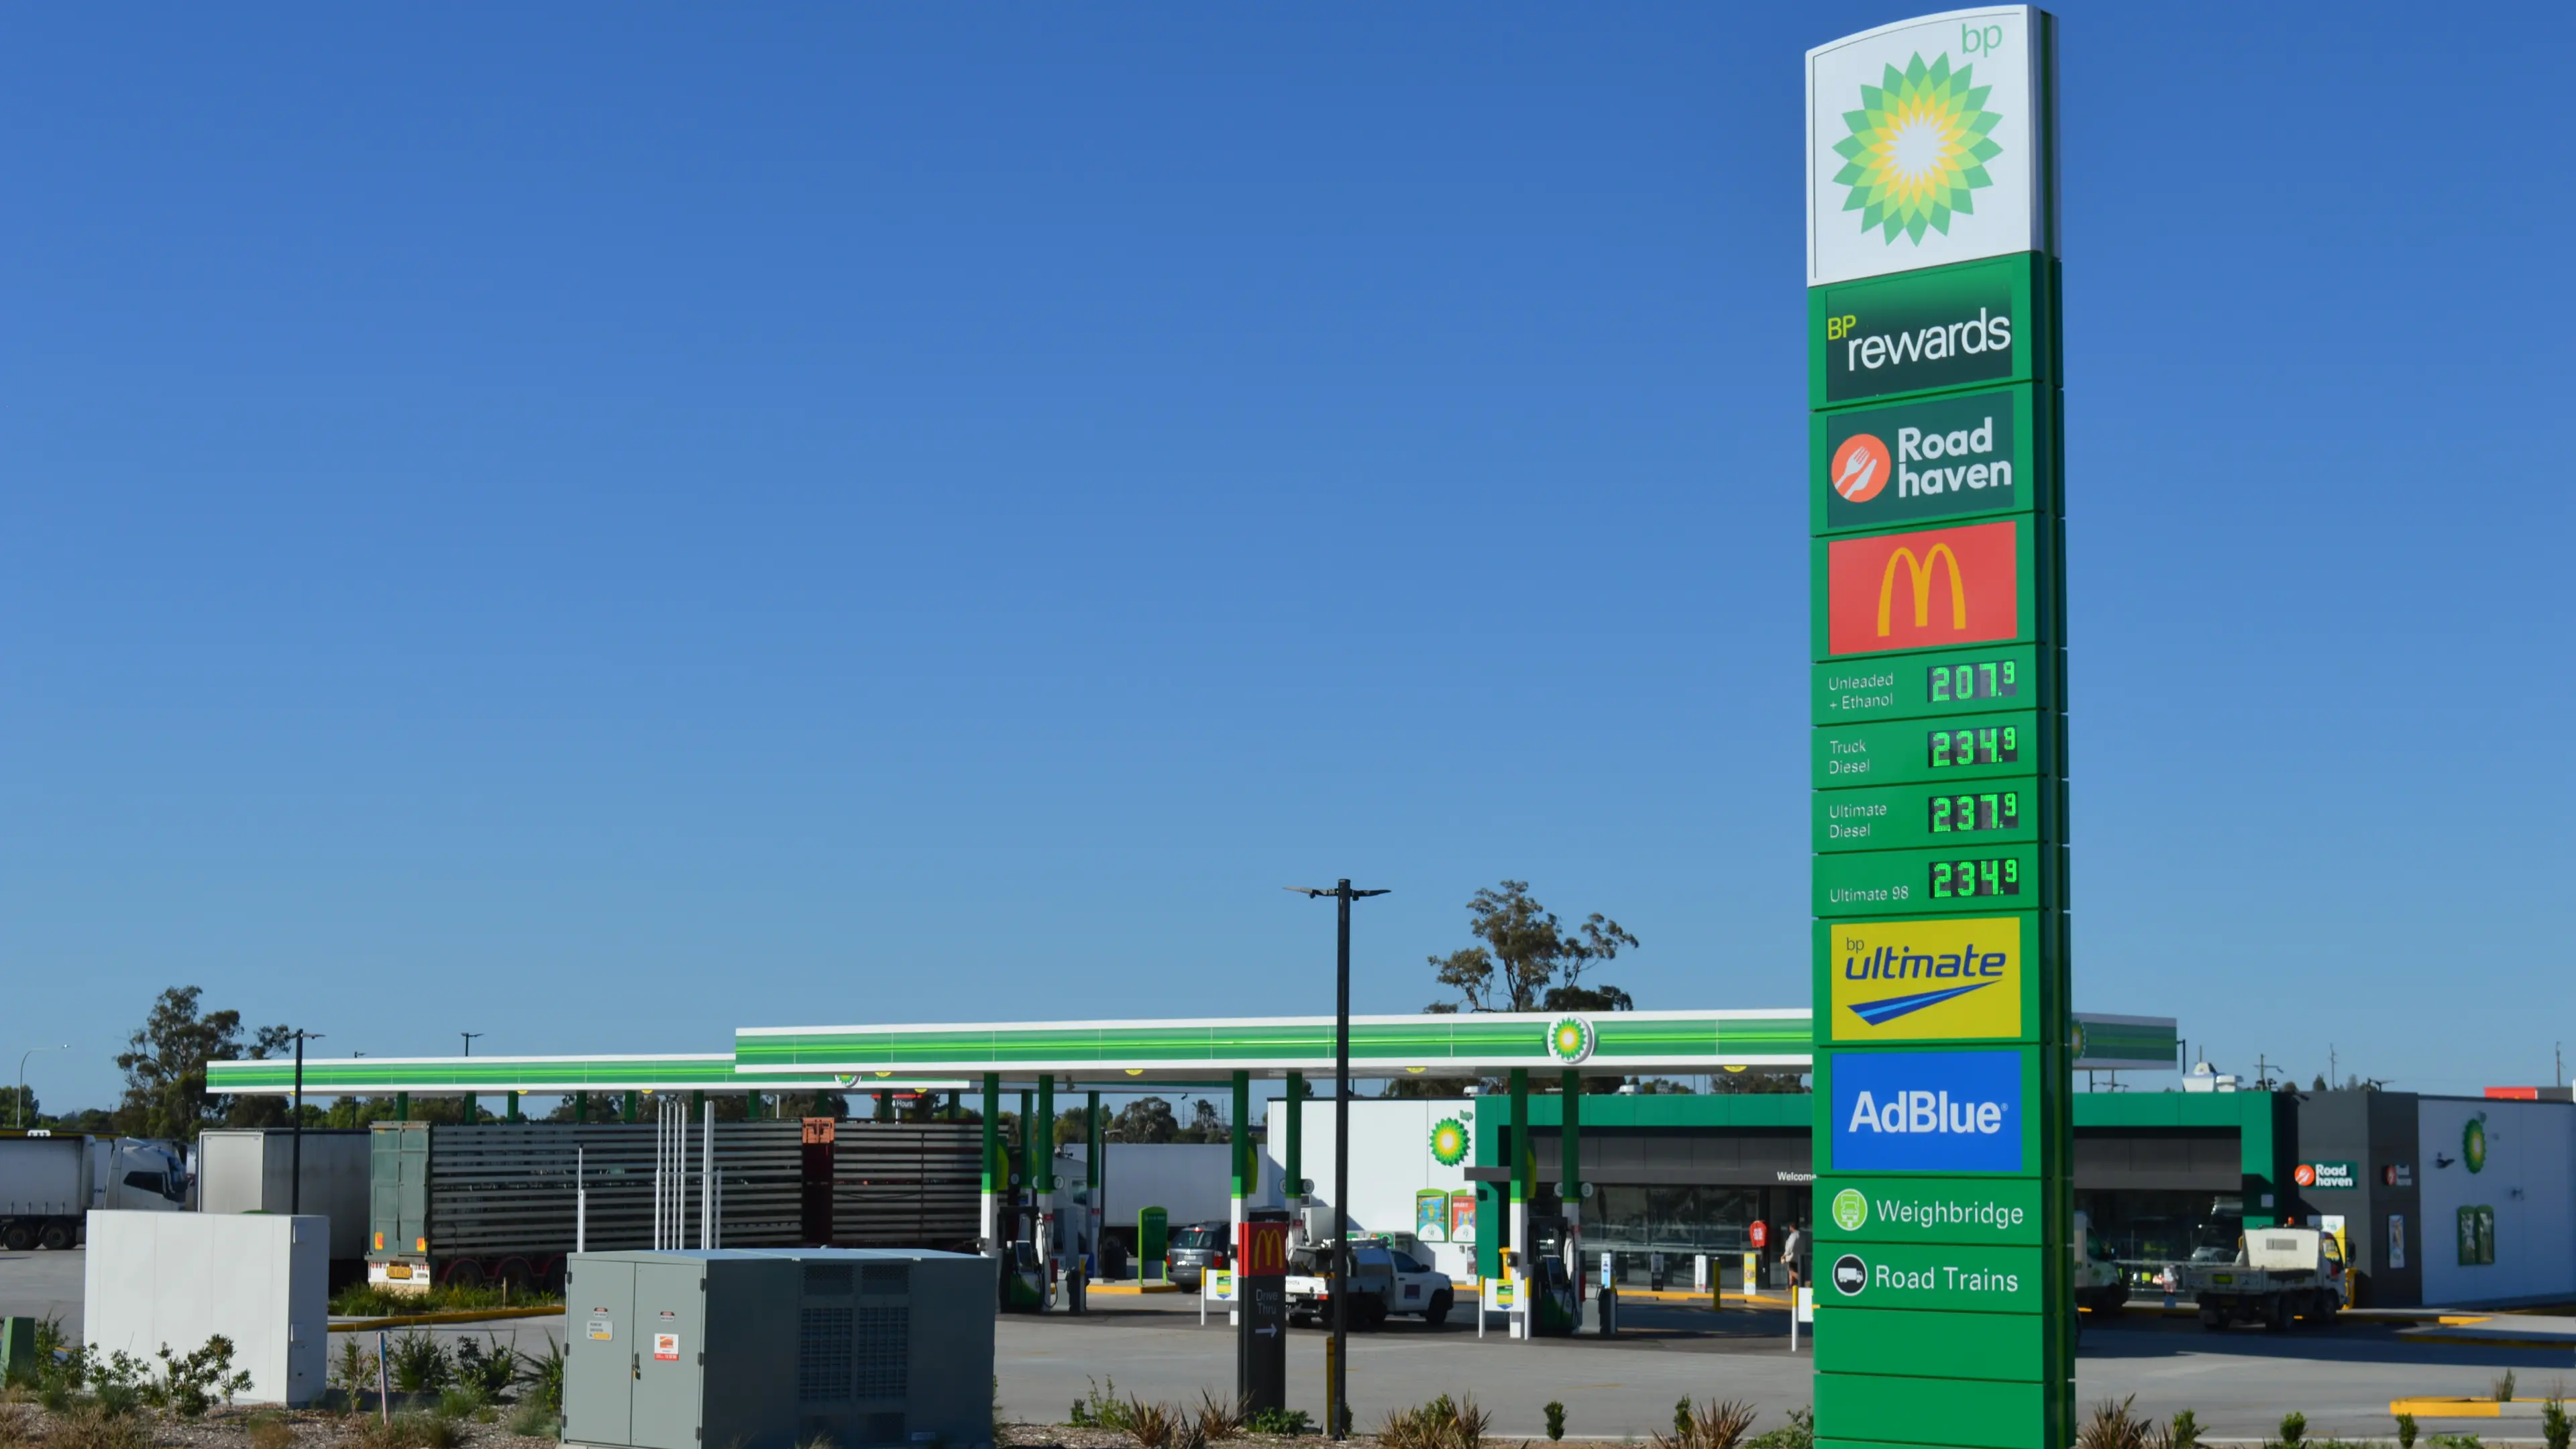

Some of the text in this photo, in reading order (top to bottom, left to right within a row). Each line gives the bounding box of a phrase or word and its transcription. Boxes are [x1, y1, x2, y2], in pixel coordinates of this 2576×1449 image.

[1962, 23, 2002, 58] bp
[1828, 315, 1856, 340] BP
[1848, 307, 2011, 371] rewards
[1898, 417, 1992, 462] Road
[1898, 460, 2012, 498] haven
[1829, 672, 1894, 691] Unleaded
[1842, 692, 1893, 709] Ethanol
[1830, 739, 1866, 754] Truck
[1829, 759, 1870, 774] Diesel
[1829, 804, 1887, 818] Ultimate
[1830, 822, 1870, 838] Diesel
[1830, 885, 1909, 902] Ultimate 98
[1846, 936, 1864, 954] bp
[1845, 944, 2006, 980] ultimate
[1776, 1171, 1817, 1182] Welcome
[2315, 1164, 2347, 1177] Road
[2316, 1177, 2353, 1187] haven
[1876, 1199, 2023, 1229] Weighbridge
[1876, 1265, 2019, 1292] Road Trains
[1256, 1288, 1278, 1301] Drive
[1257, 1302, 1277, 1315] Thru
